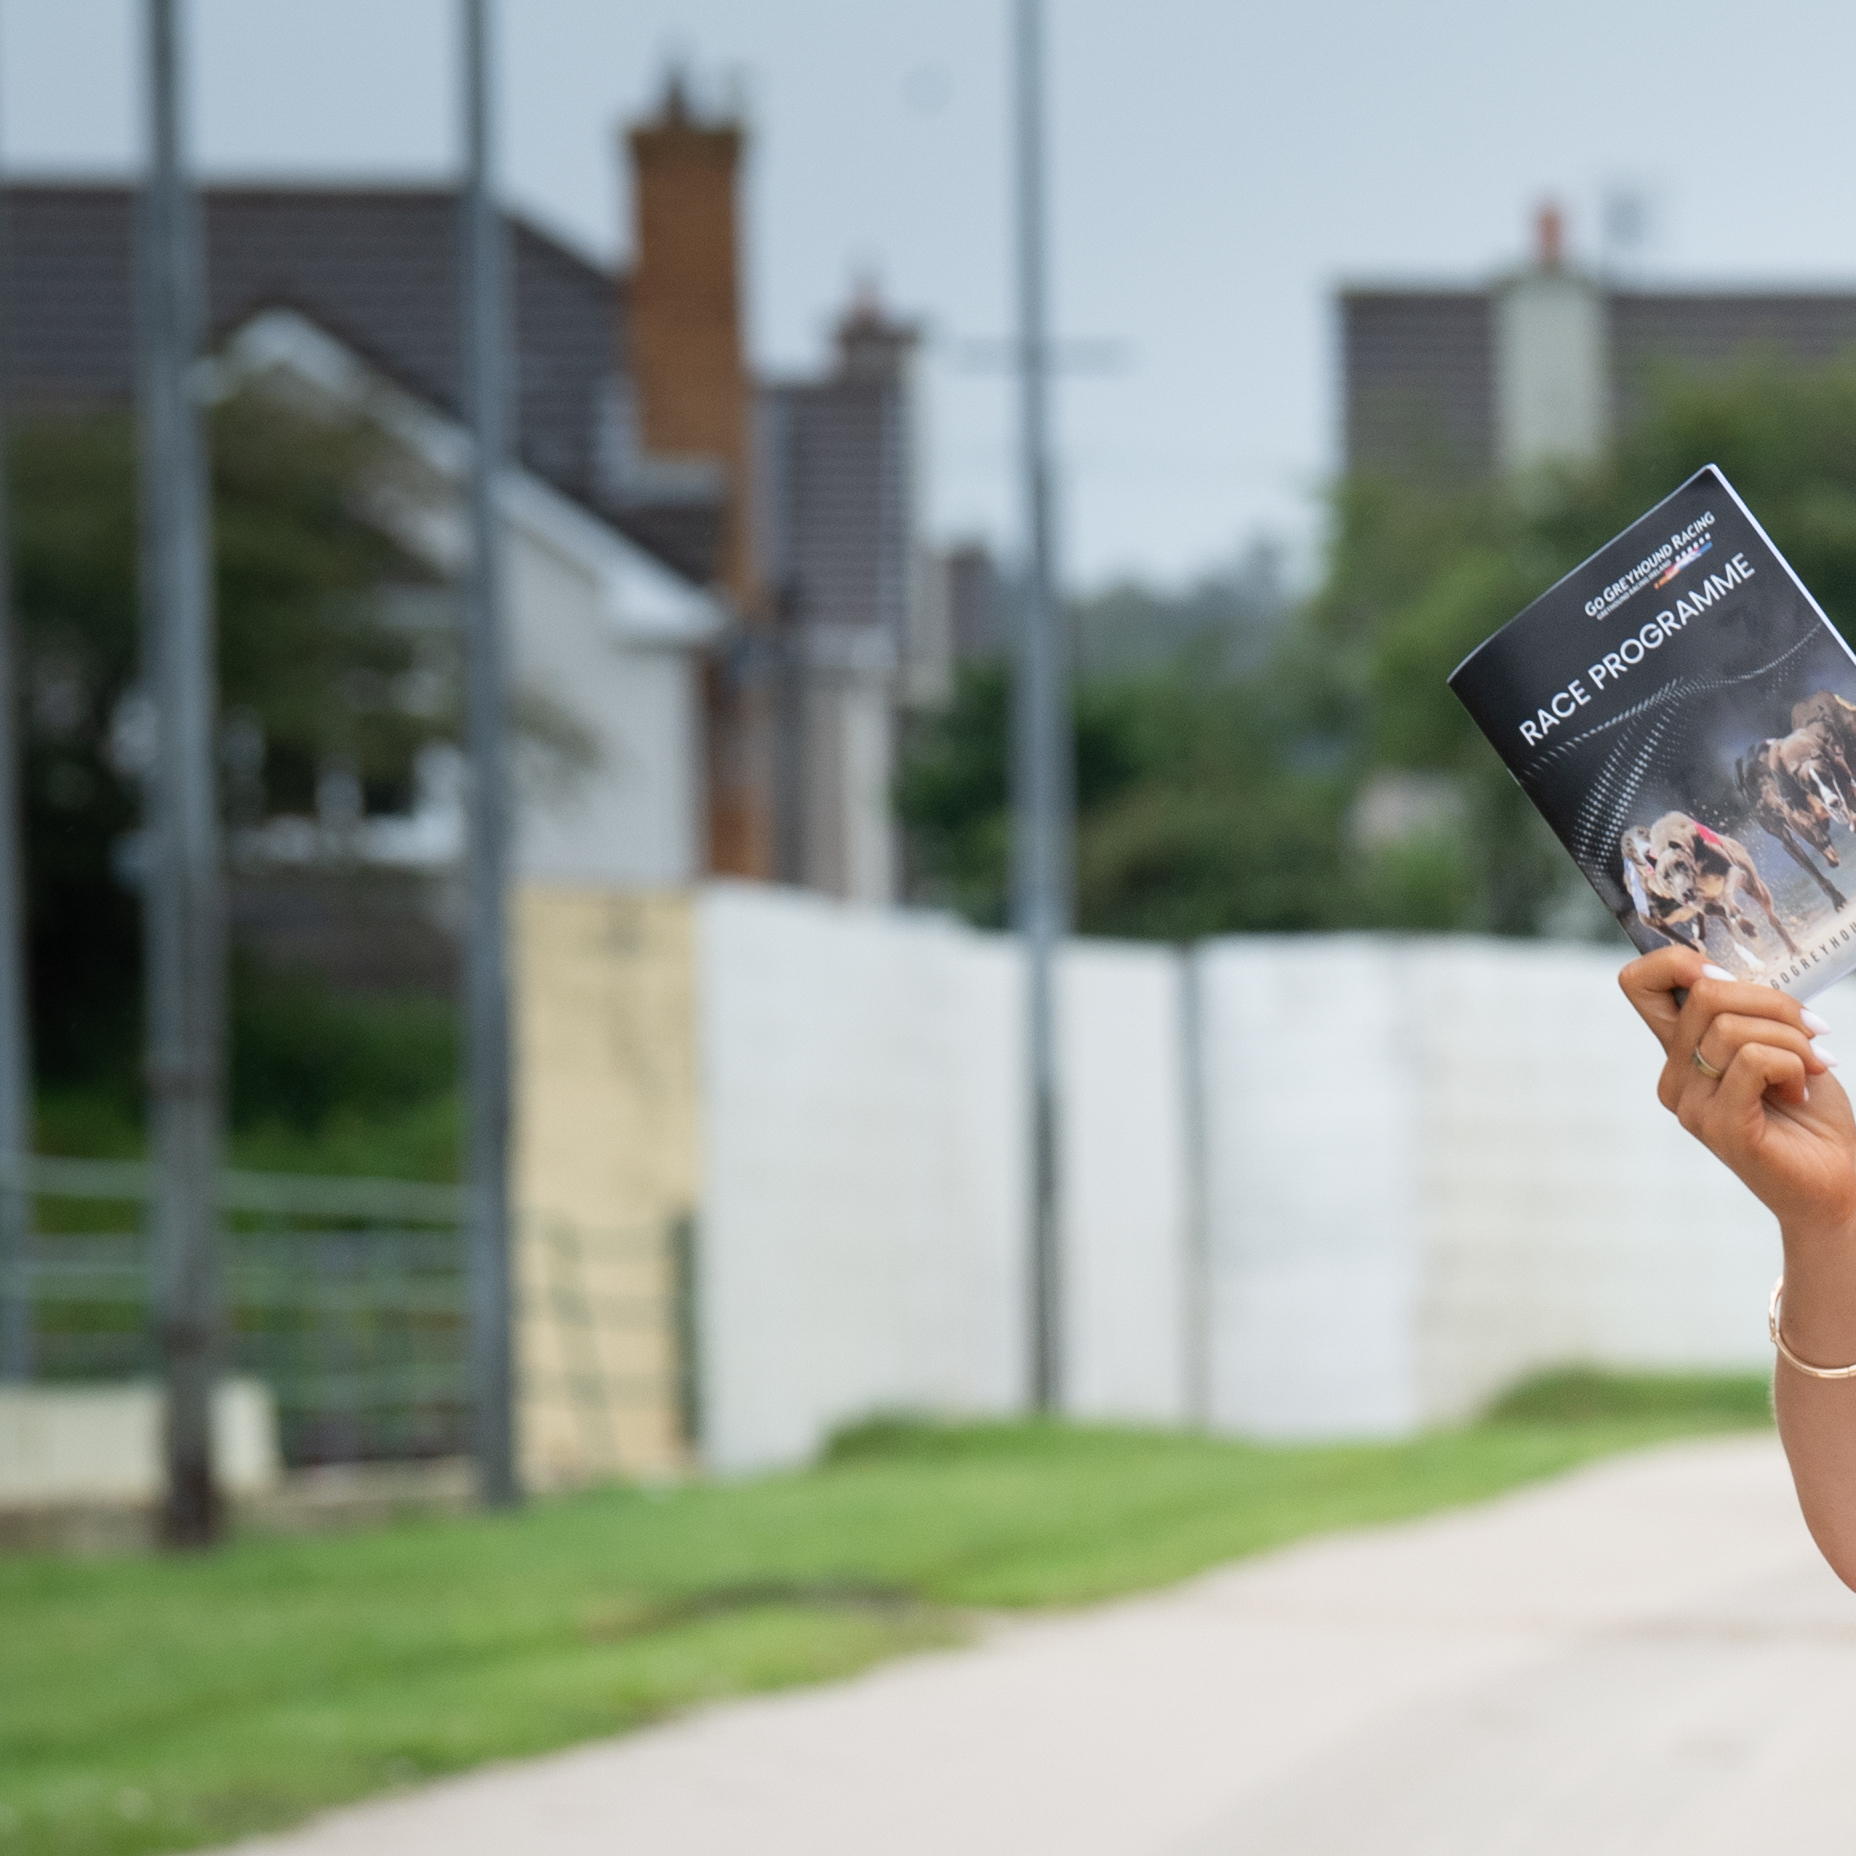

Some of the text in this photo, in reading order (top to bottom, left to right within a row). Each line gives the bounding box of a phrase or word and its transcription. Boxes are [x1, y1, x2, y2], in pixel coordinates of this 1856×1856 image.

[1584, 511, 1716, 616] GO GREYHOUND RACING
[1518, 552, 1756, 747] RACE PROGRAMME
